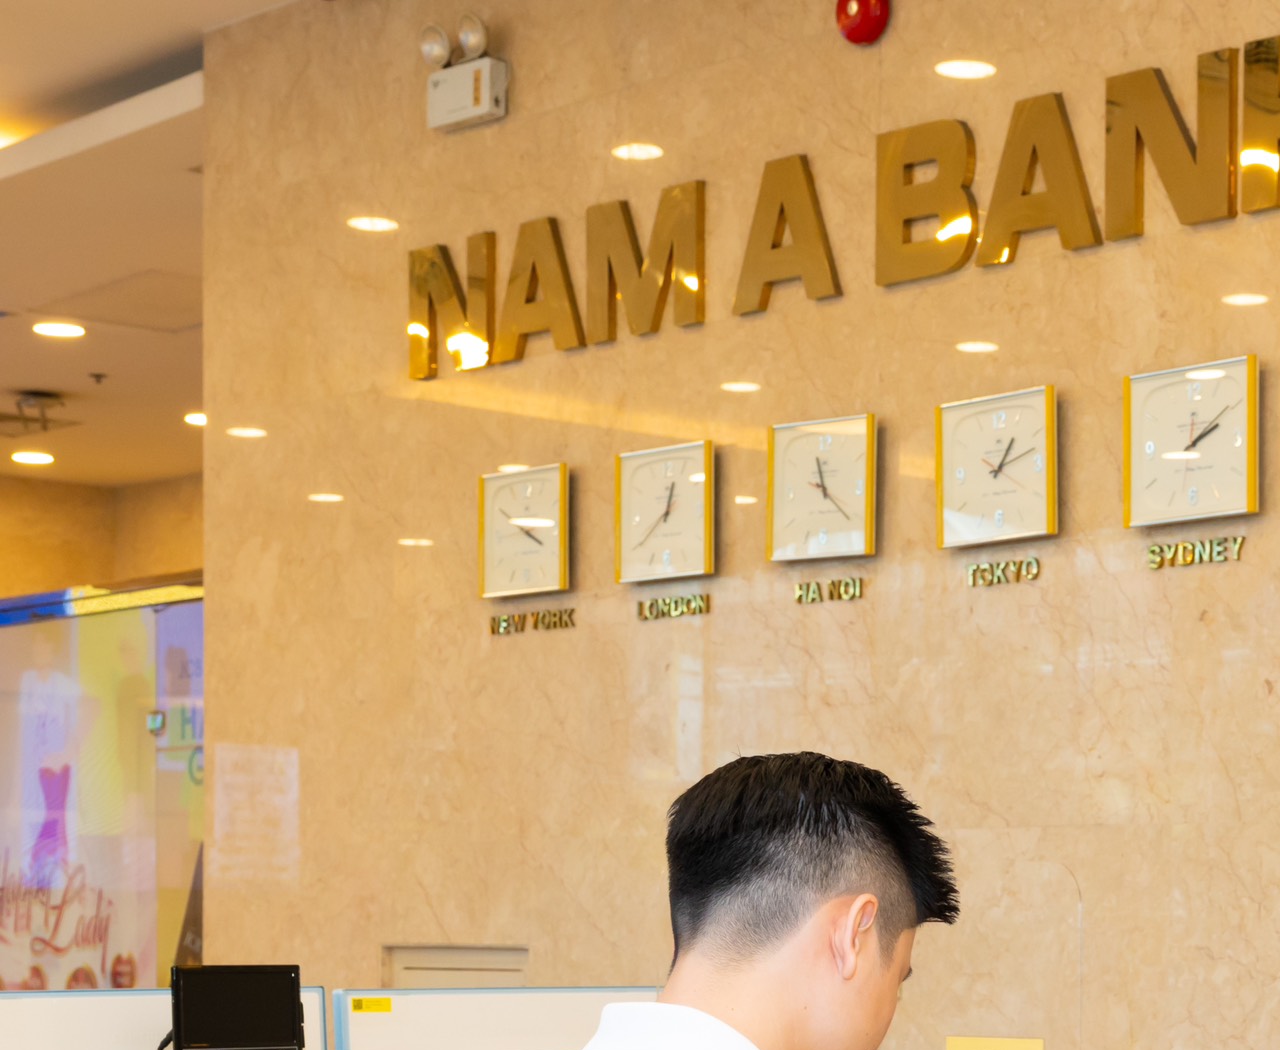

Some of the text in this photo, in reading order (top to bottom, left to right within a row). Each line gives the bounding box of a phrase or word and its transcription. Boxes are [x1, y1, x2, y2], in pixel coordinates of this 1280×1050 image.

[408, 180, 706, 380] NAM
[732, 153, 842, 316] A
[992, 411, 1006, 428] 12
[1147, 535, 1246, 570] SYDNEY
[967, 556, 1041, 588] TOKYO
[794, 577, 863, 604] HA NOI
[637, 594, 711, 621] LONDON
[490, 608, 575, 635] NEW YORK
